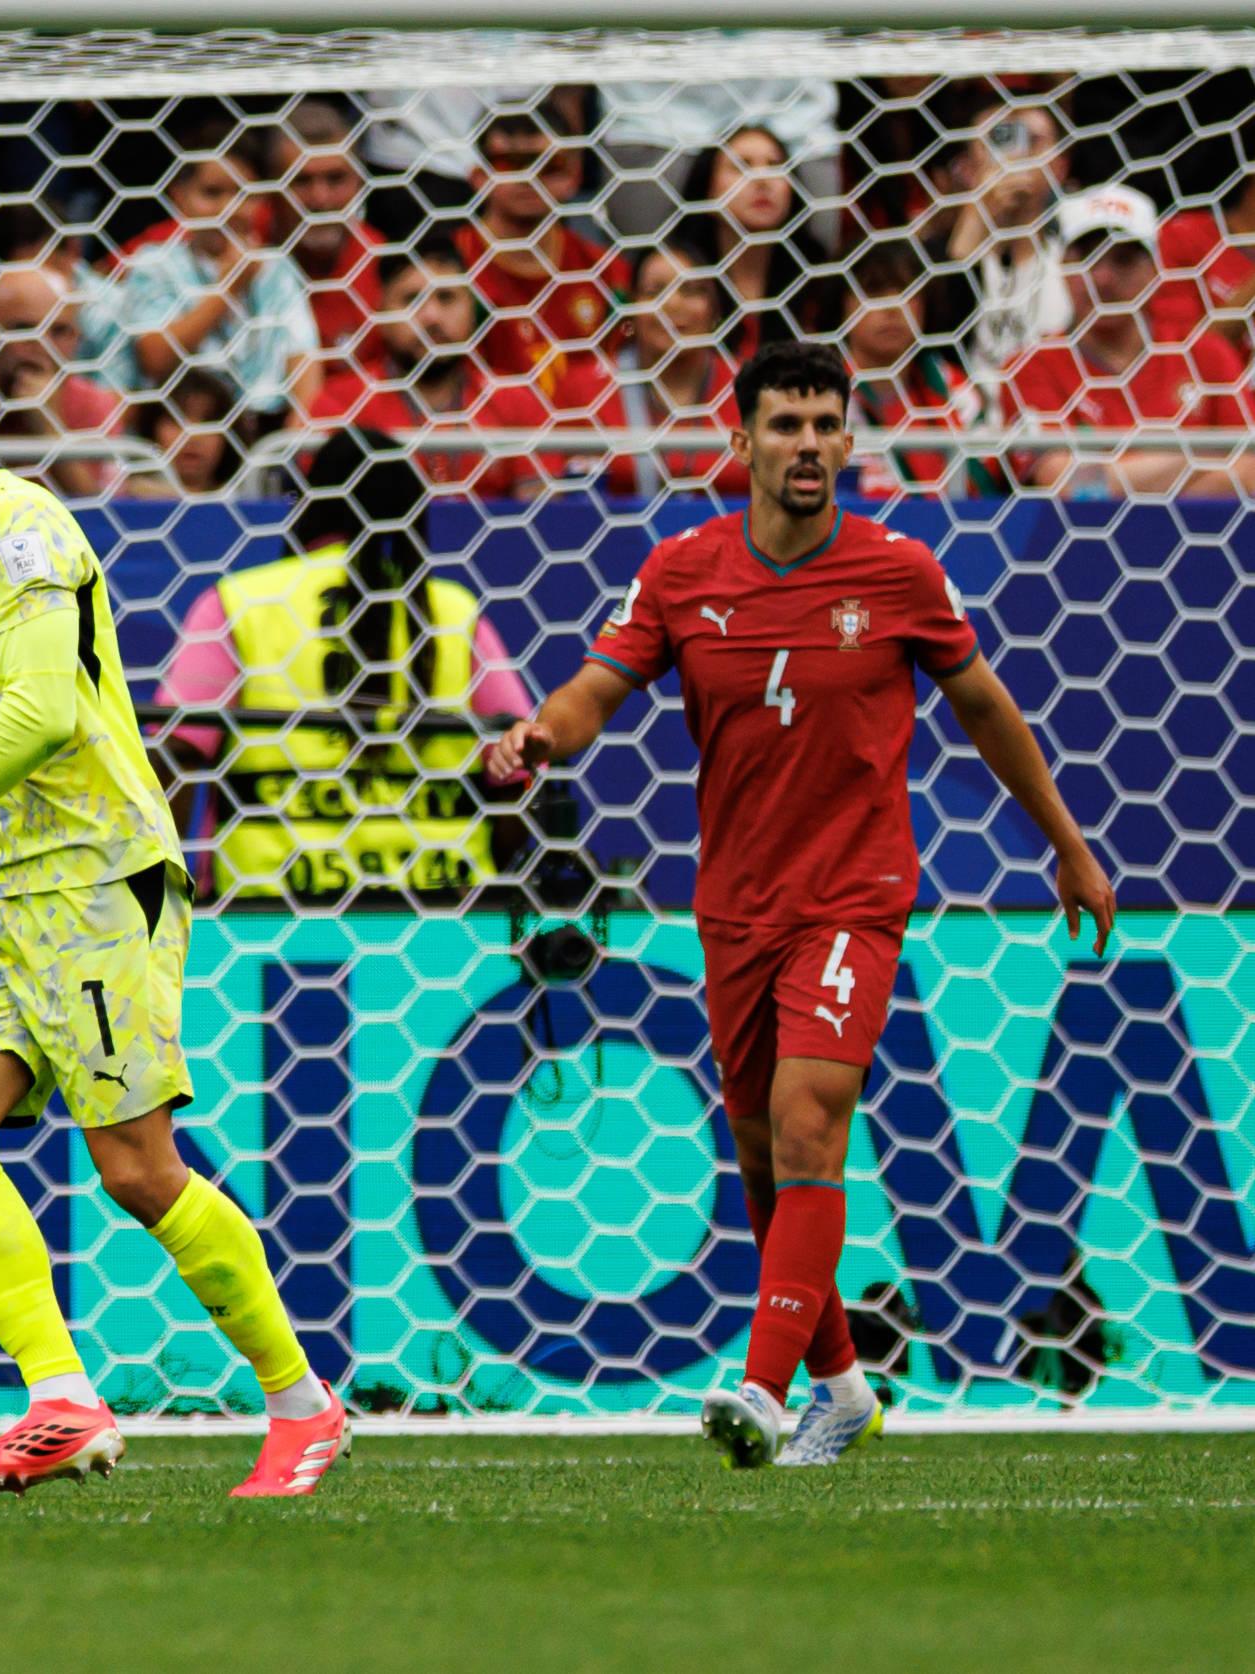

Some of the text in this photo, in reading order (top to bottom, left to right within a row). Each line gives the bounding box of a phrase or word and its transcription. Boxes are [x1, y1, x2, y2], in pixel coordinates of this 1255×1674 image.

[764, 649, 796, 727] 4
[820, 930, 856, 1005] 4
[81, 979, 116, 1057] 1
